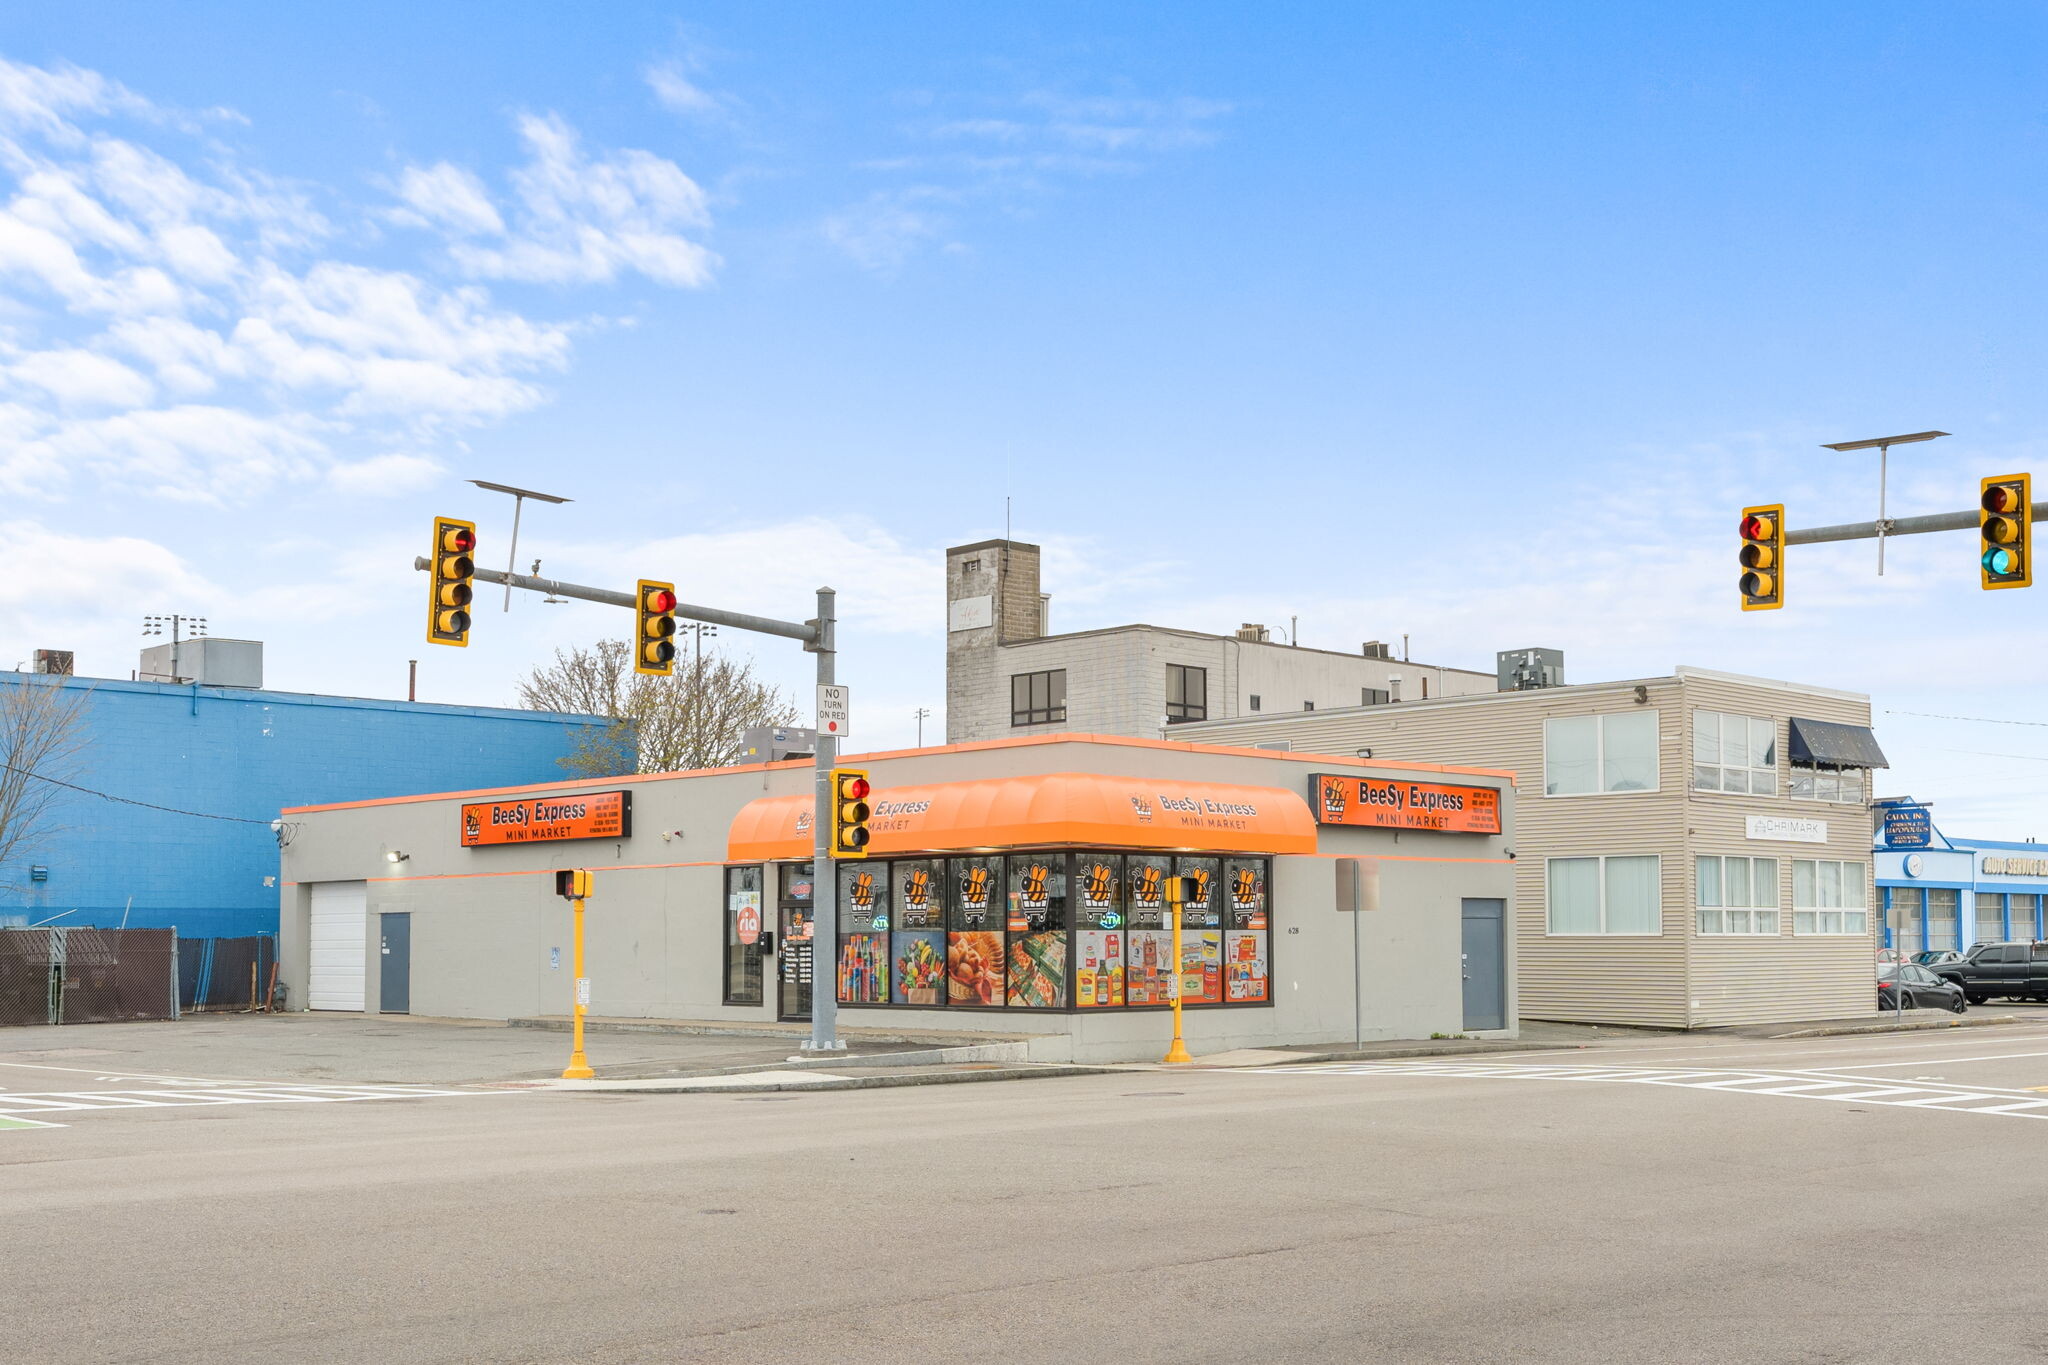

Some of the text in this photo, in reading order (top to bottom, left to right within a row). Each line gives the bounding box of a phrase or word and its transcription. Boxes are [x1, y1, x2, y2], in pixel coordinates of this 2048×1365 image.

[825, 688, 840, 699] NO
[823, 700, 842, 709] TURN
[819, 710, 846, 720] ON RED
[1359, 782, 1406, 811] BeeSy
[1409, 785, 1463, 812] Express
[873, 799, 931, 819] Express
[1159, 795, 1257, 817] BeeSy Express
[492, 804, 531, 826] BeeSy
[534, 802, 587, 825] Express
[1376, 813, 1449, 828] MINI MARKET
[867, 820, 909, 831] MARKET
[1181, 817, 1247, 830] MINI MARKET
[506, 826, 572, 841] MINI MARKET
[1983, 857, 2005, 874] AUTO
[2005, 858, 2037, 876] SERVICE
[739, 912, 758, 931] ria
